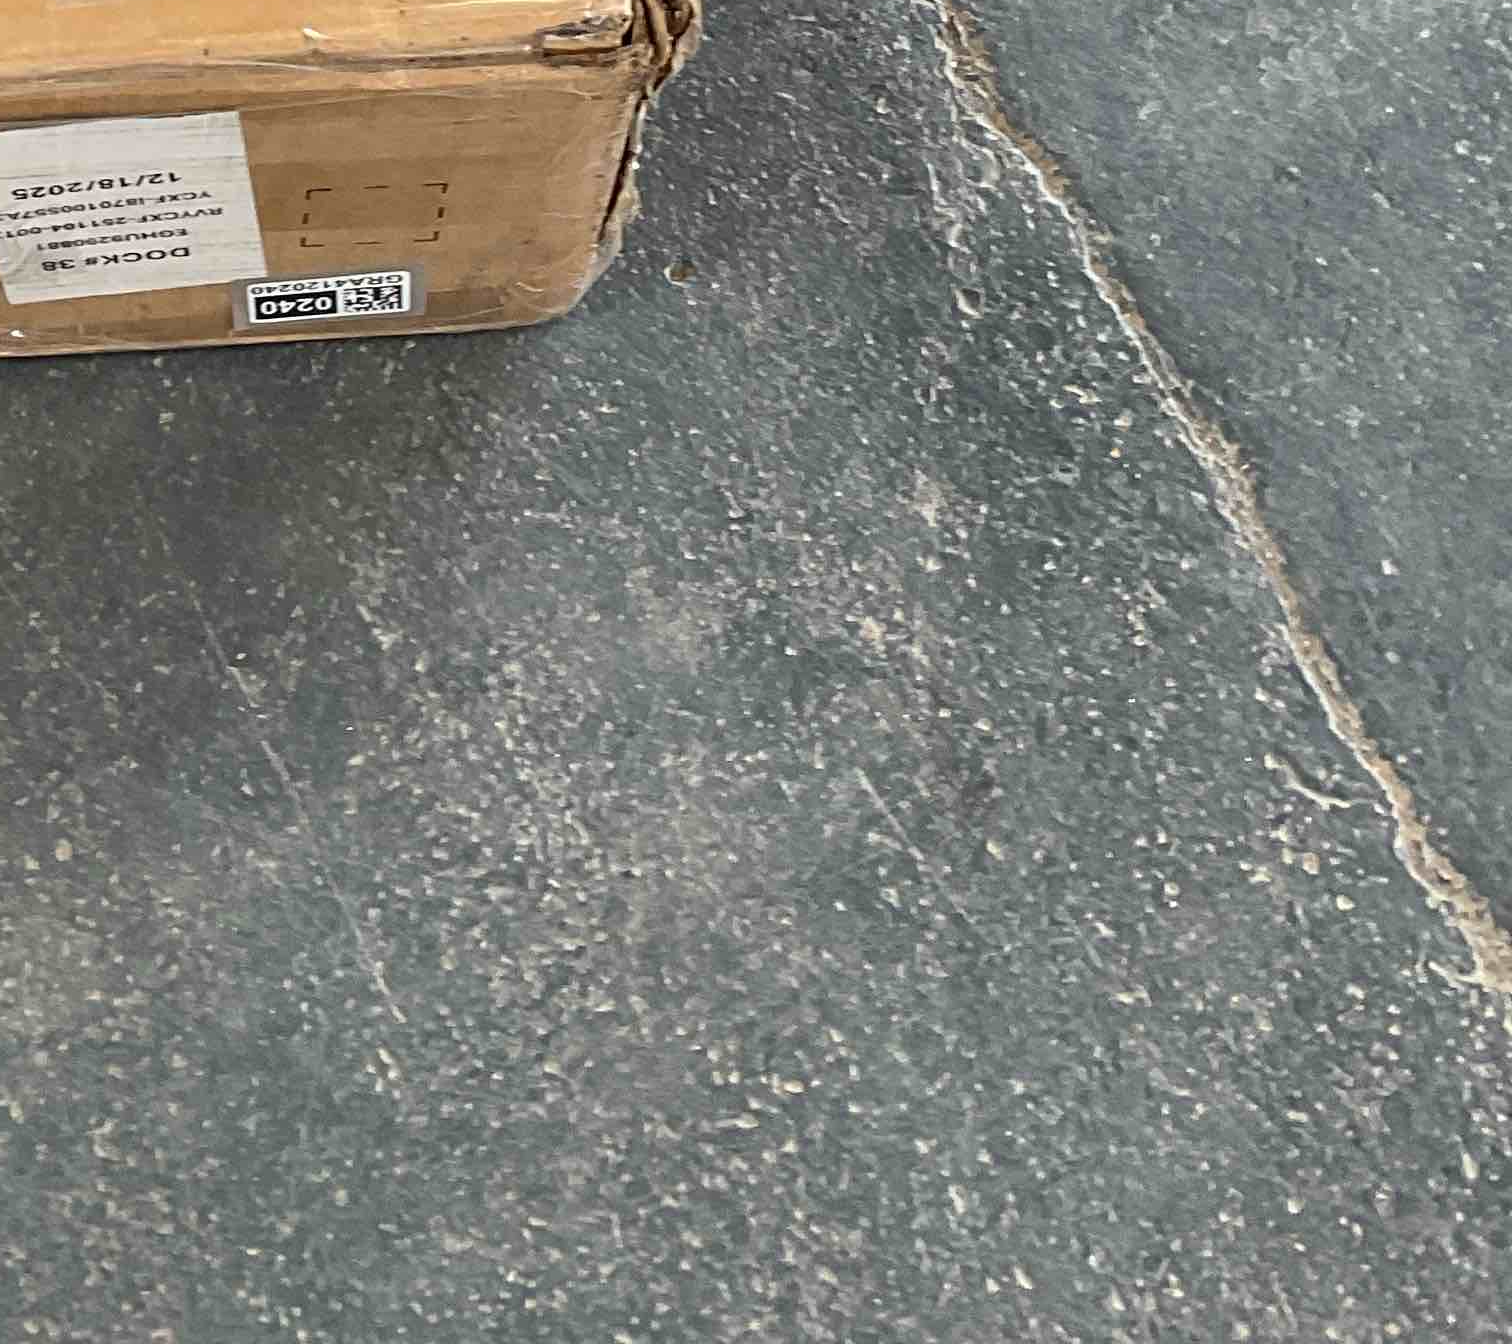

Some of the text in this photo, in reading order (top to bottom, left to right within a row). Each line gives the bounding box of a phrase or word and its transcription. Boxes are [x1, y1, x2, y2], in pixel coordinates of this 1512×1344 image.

[11, 172, 183, 201] 12/18/2025
[41, 246, 191, 272] DOCK# 38
[250, 274, 404, 296] GRA4120240
[260, 296, 333, 315] 0240
